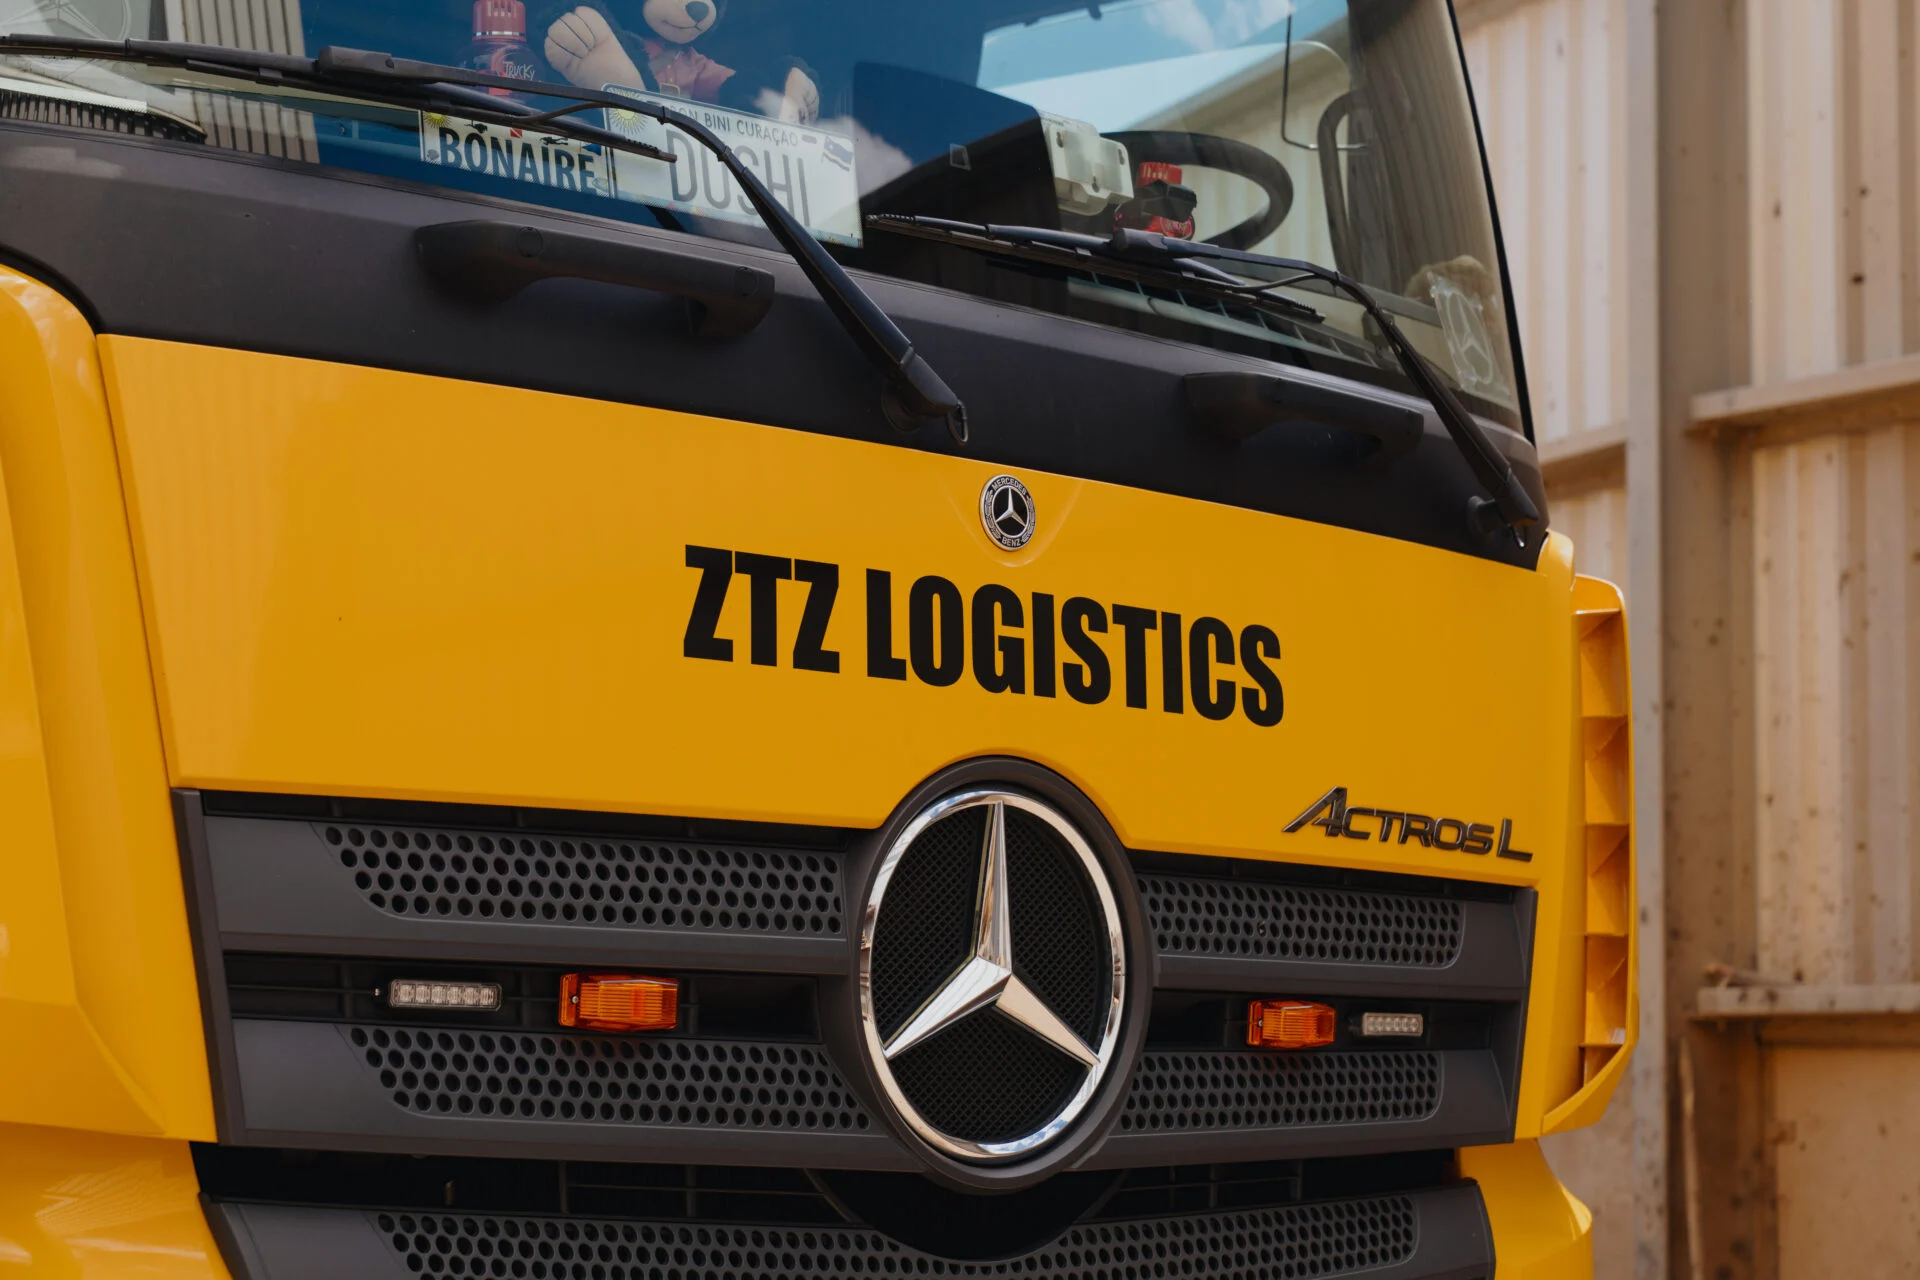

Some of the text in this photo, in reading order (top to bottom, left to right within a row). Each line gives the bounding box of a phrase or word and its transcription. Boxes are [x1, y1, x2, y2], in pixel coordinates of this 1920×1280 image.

[704, 112, 731, 132] BINI
[737, 120, 799, 146] CURAÇAO
[439, 127, 597, 194] BONAIRE
[992, 477, 1027, 496] MERCEDES
[1002, 537, 1021, 547] BENZ
[683, 544, 1285, 728] ZTZ LOGISTICS
[1281, 786, 1534, 863] ACTROS L
